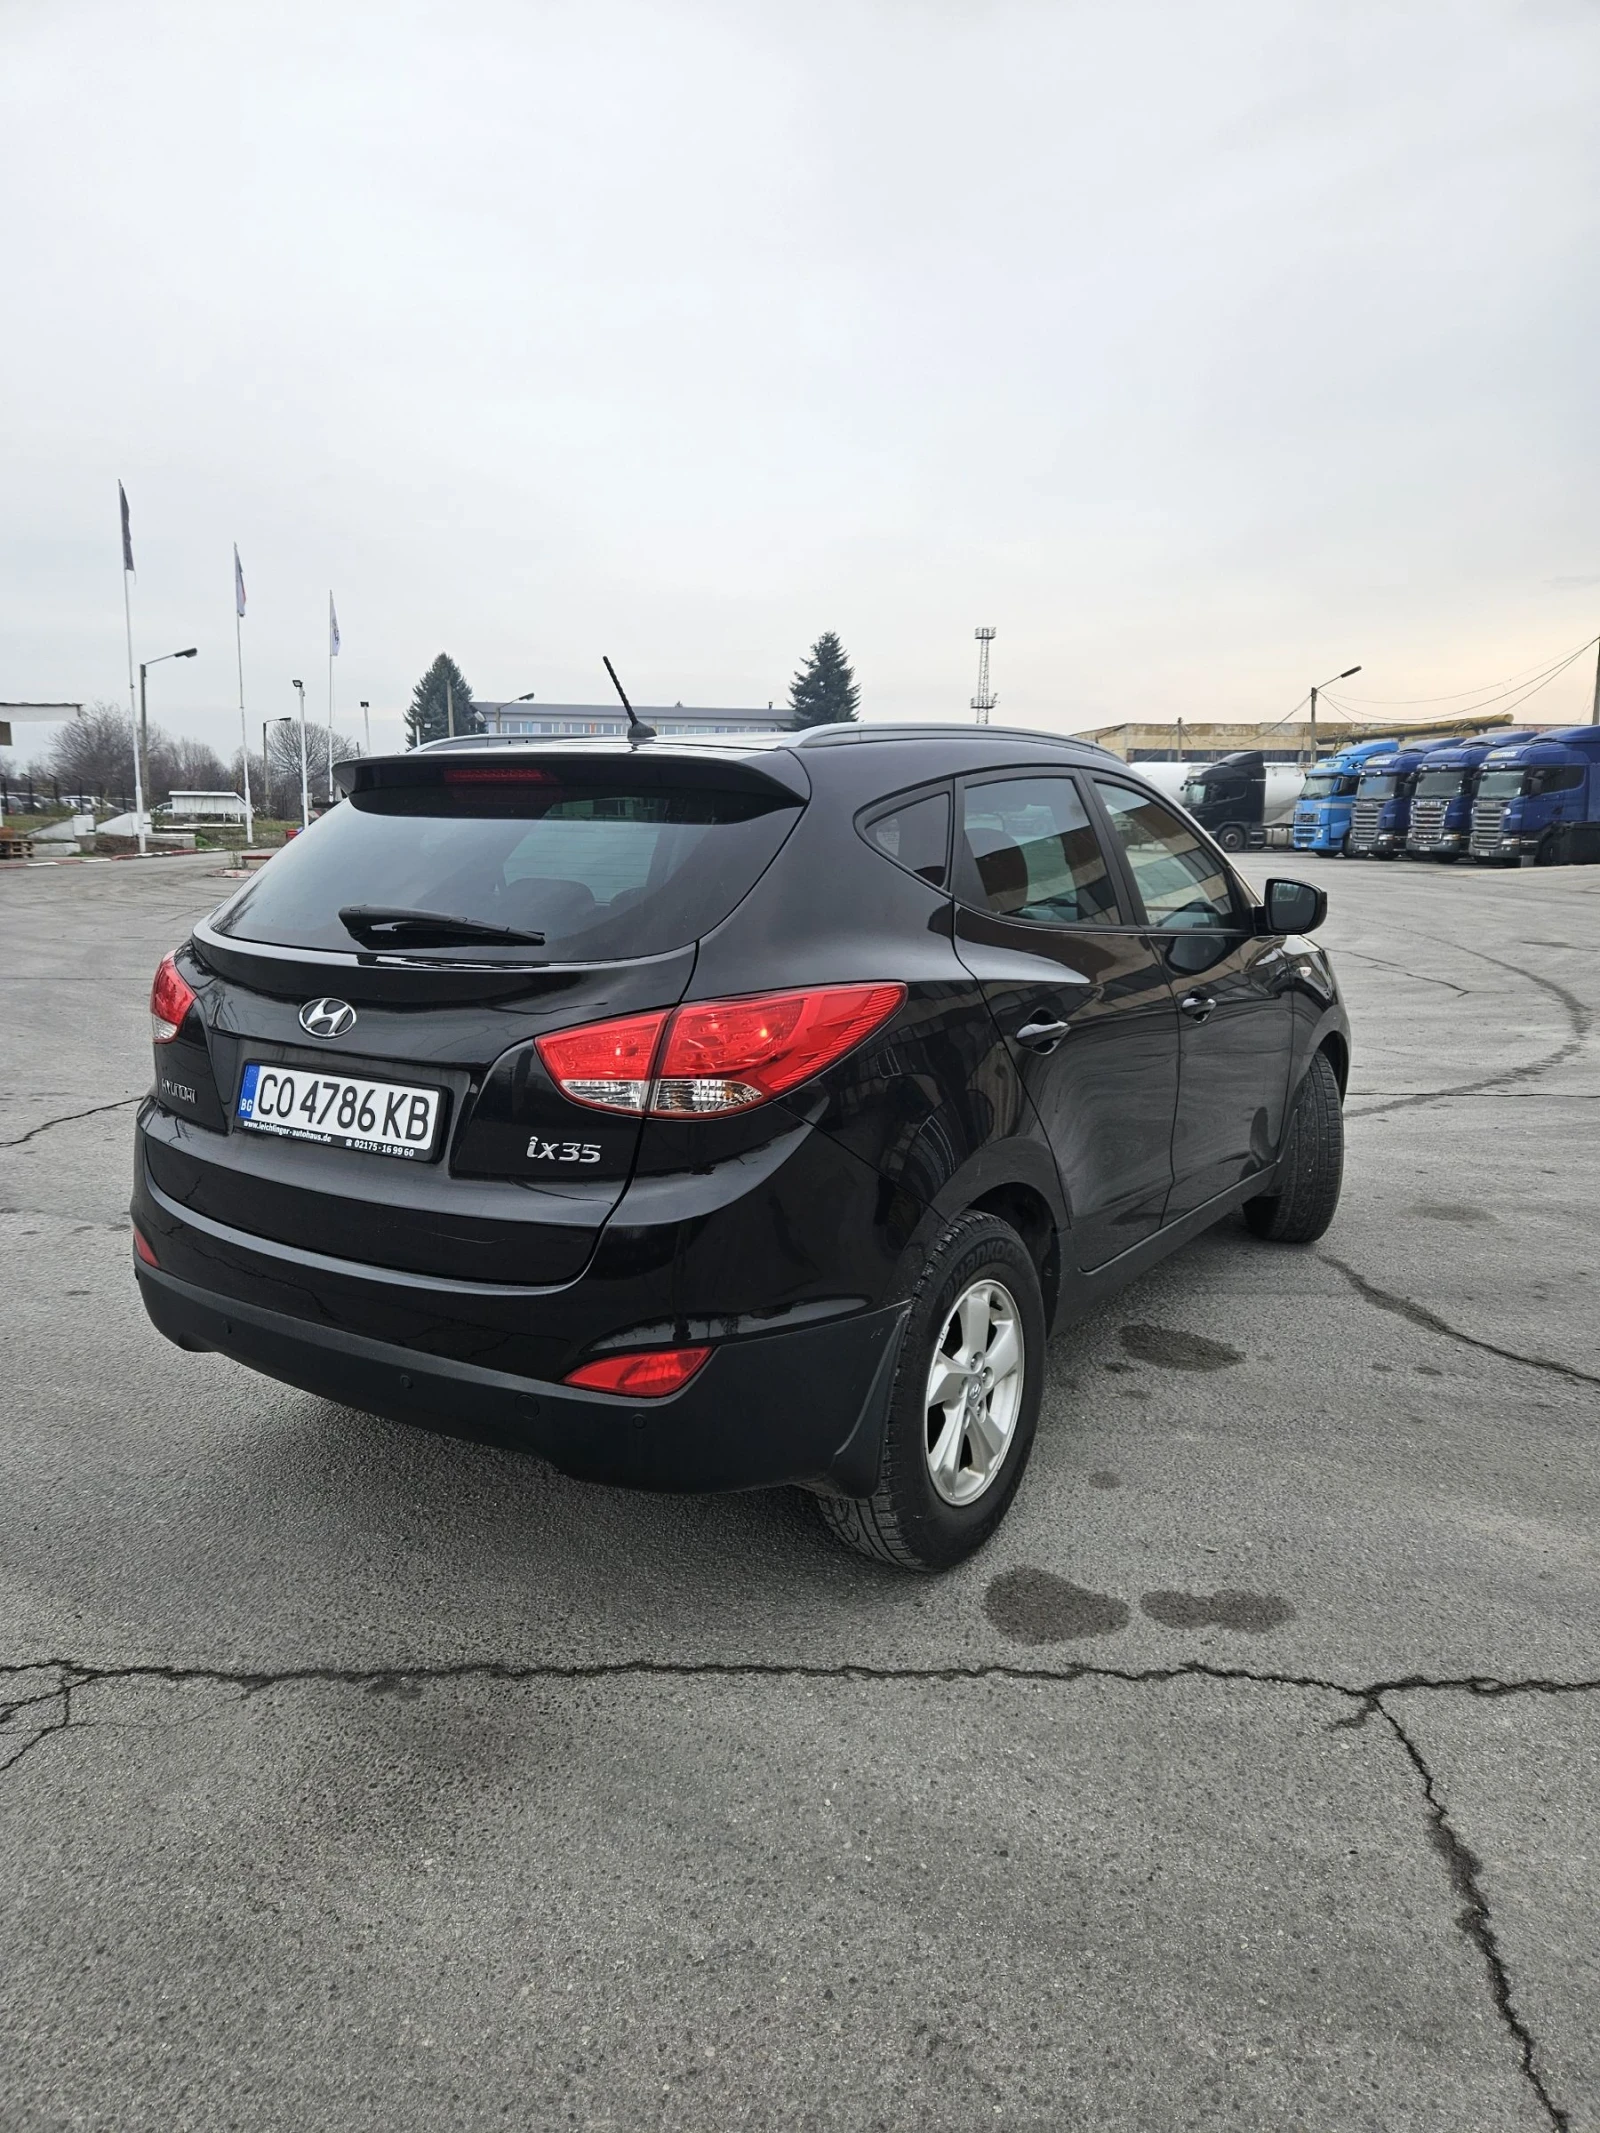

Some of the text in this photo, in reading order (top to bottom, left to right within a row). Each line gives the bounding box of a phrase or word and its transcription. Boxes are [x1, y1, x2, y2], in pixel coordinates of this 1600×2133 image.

[239, 1097, 253, 1112] BG
[257, 1074, 431, 1141] CO 4786 KB
[392, 1146, 403, 1155] 99
[404, 1148, 415, 1157] 60
[526, 1136, 602, 1164] ix35
